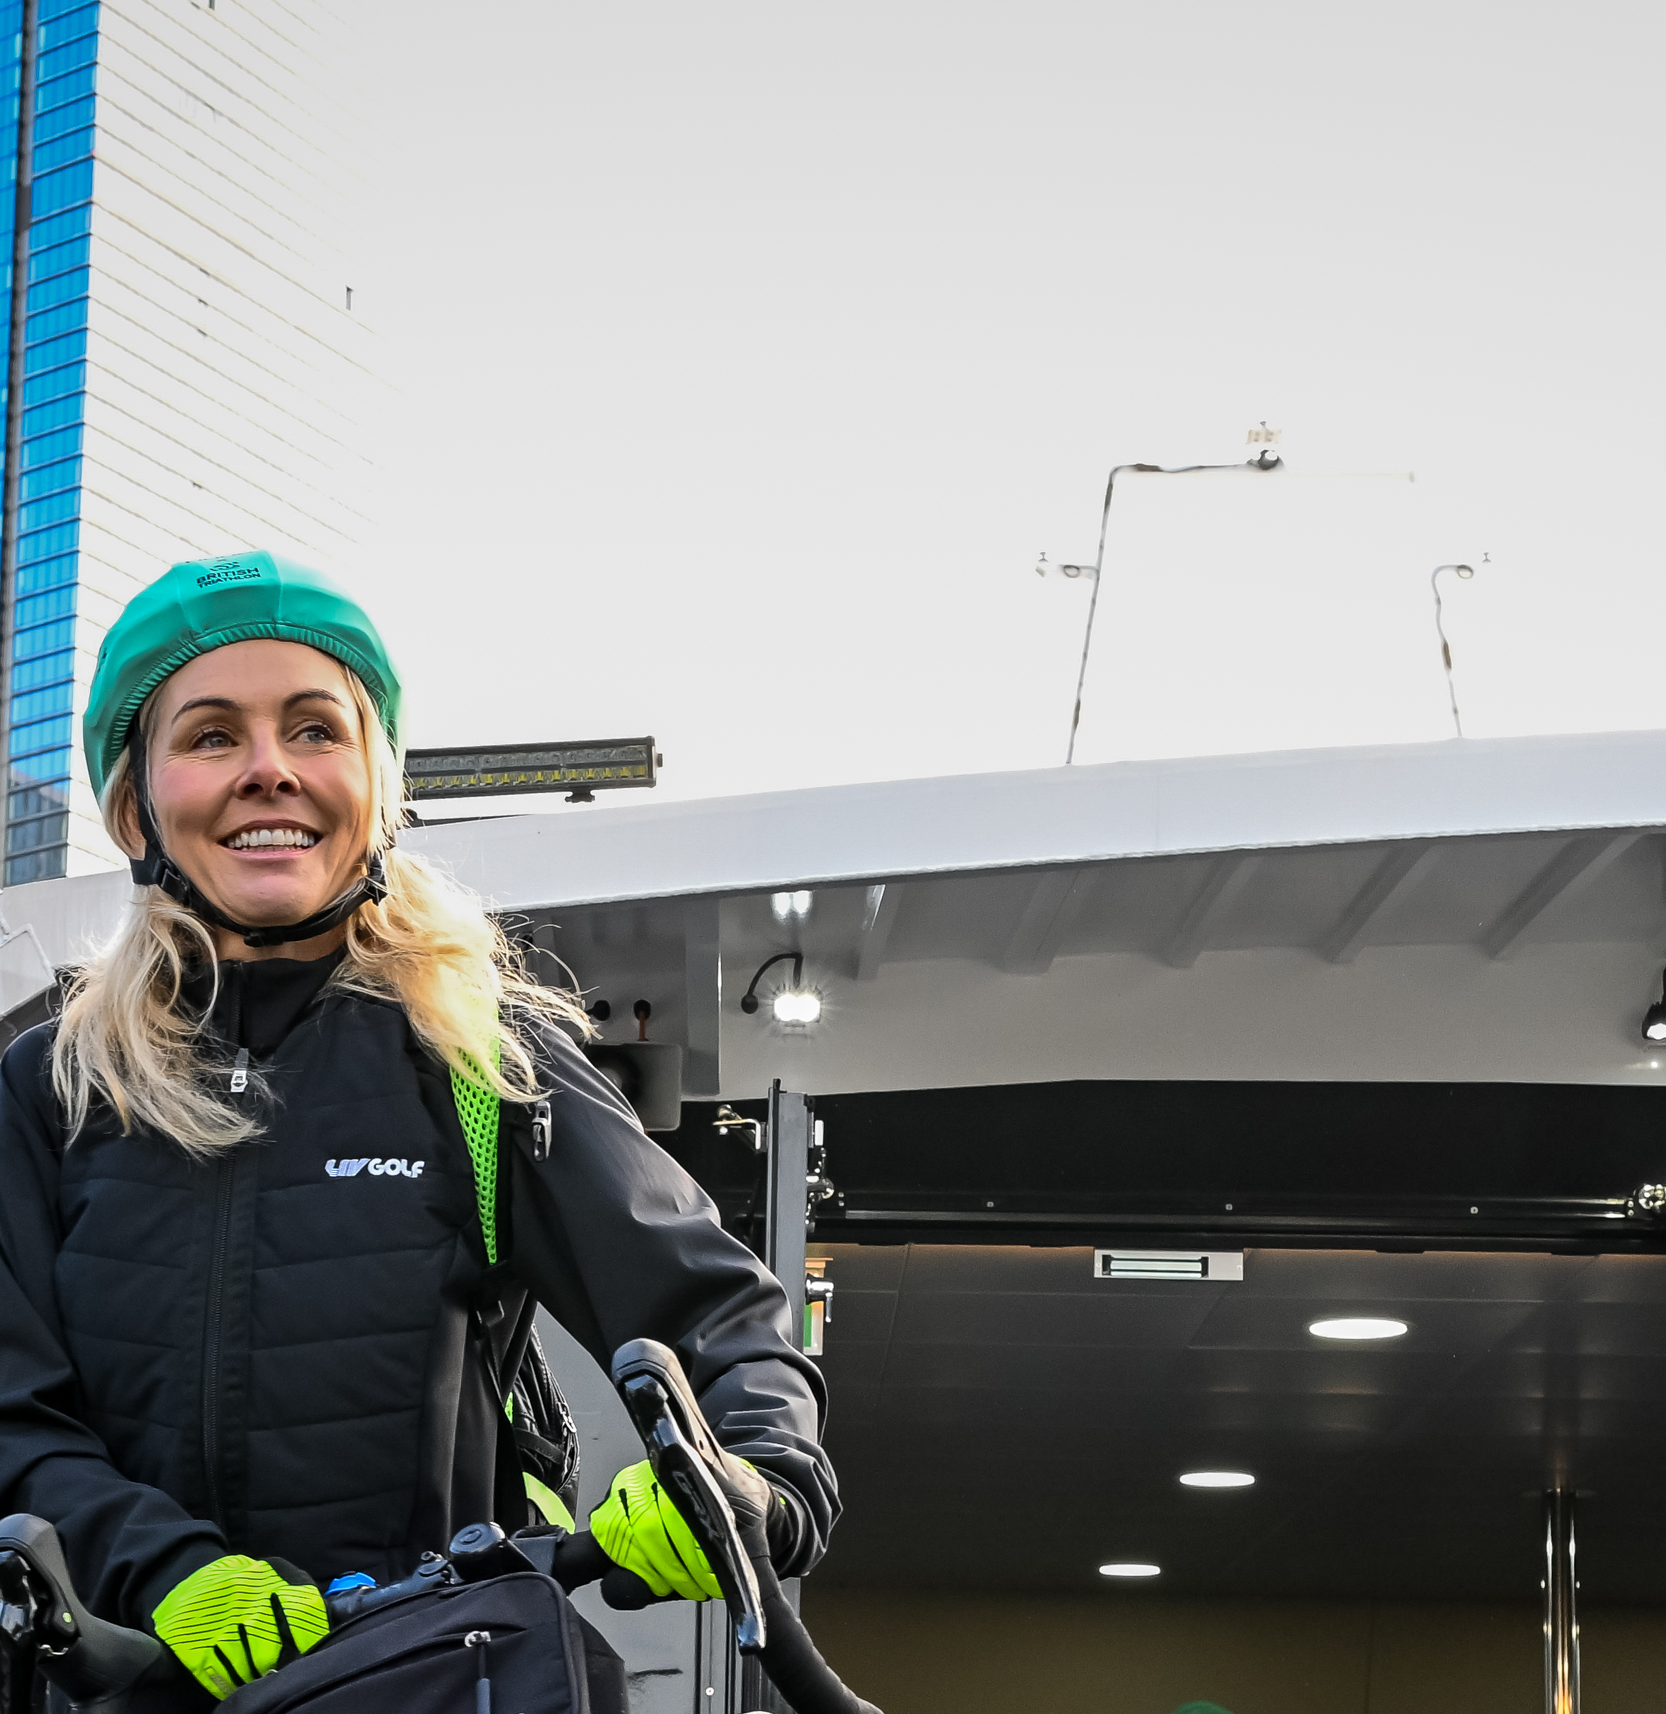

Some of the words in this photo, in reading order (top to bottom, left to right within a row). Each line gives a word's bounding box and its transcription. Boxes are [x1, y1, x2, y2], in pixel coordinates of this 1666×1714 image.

[196, 567, 260, 584] BRITISH
[198, 573, 261, 588] TRIATHLON
[324, 1158, 371, 1177] LIV
[368, 1158, 425, 1178] GOLF
